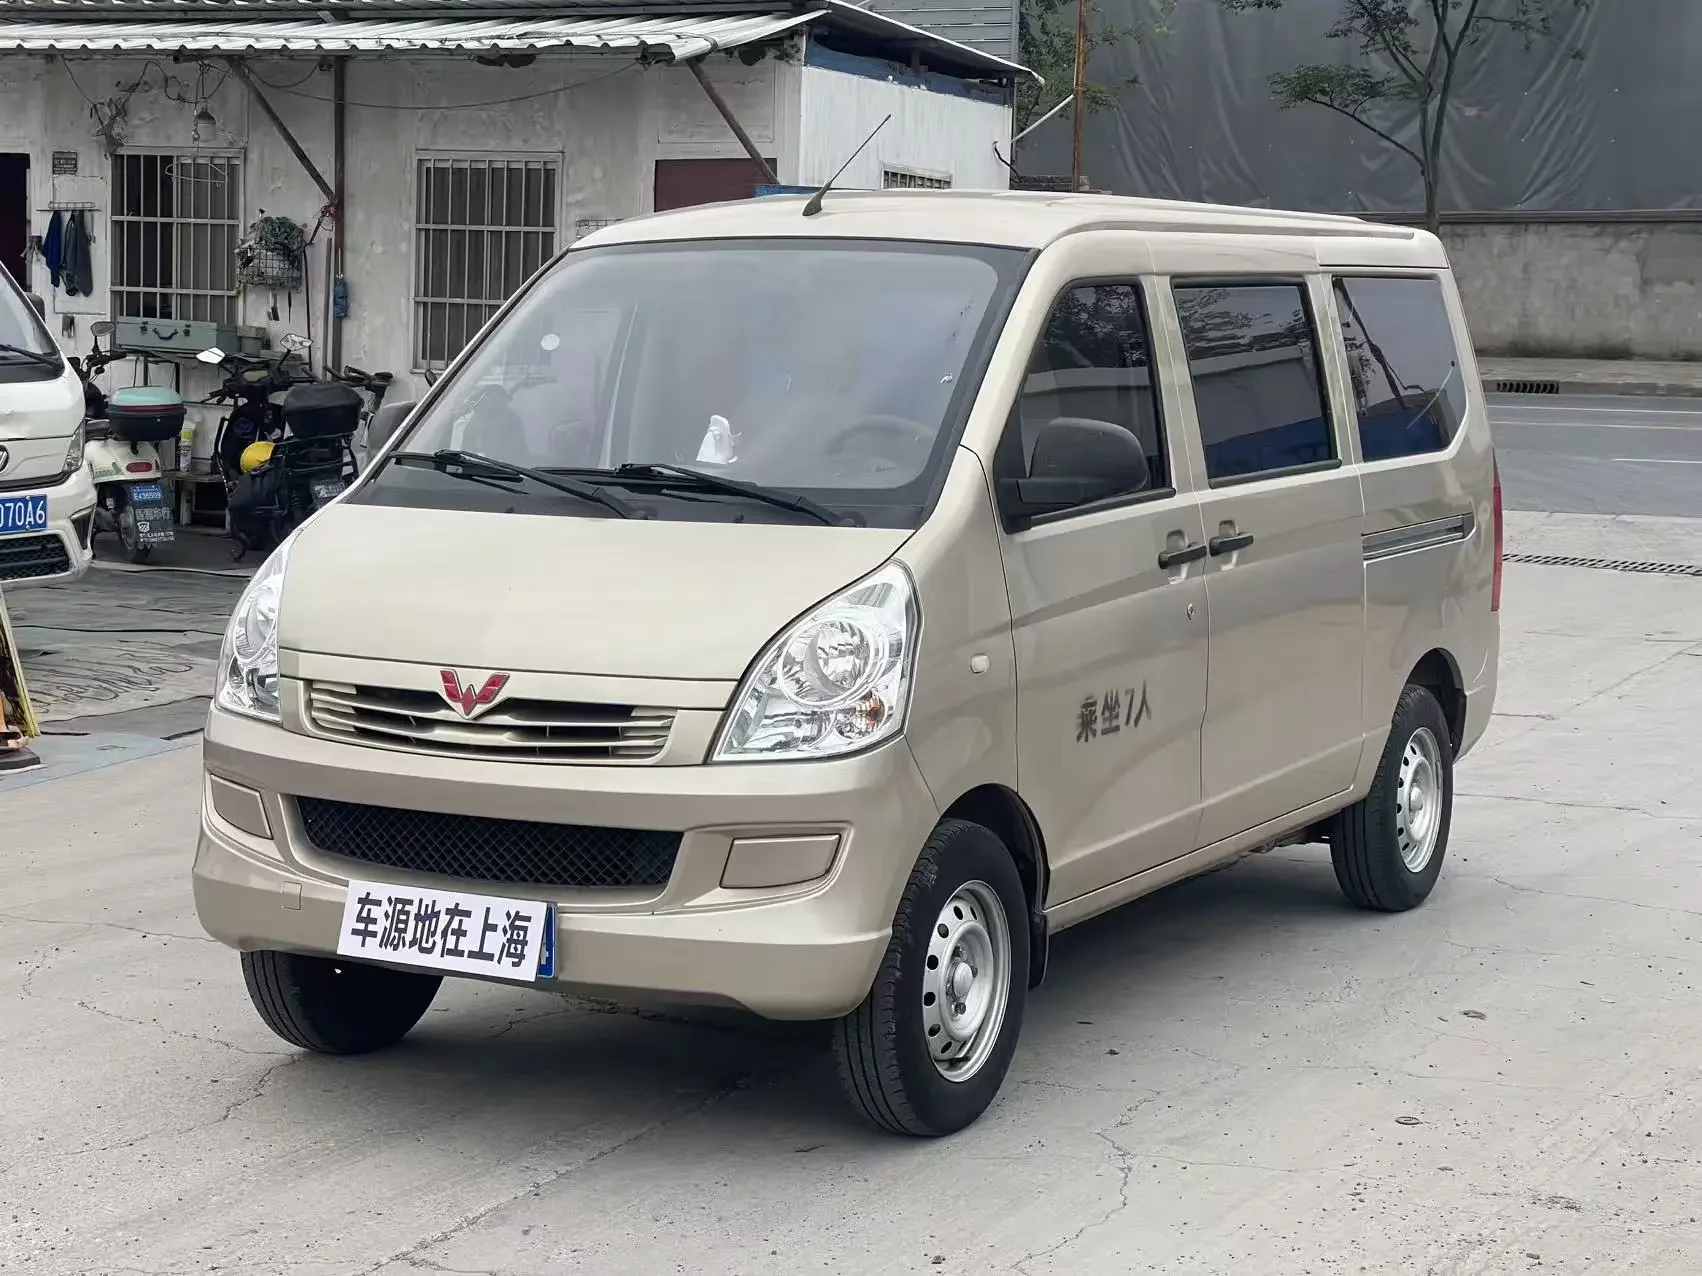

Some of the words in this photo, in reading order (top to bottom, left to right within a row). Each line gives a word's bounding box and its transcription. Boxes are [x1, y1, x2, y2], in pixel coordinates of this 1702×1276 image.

[350, 891, 532, 968] 车源地在上海
